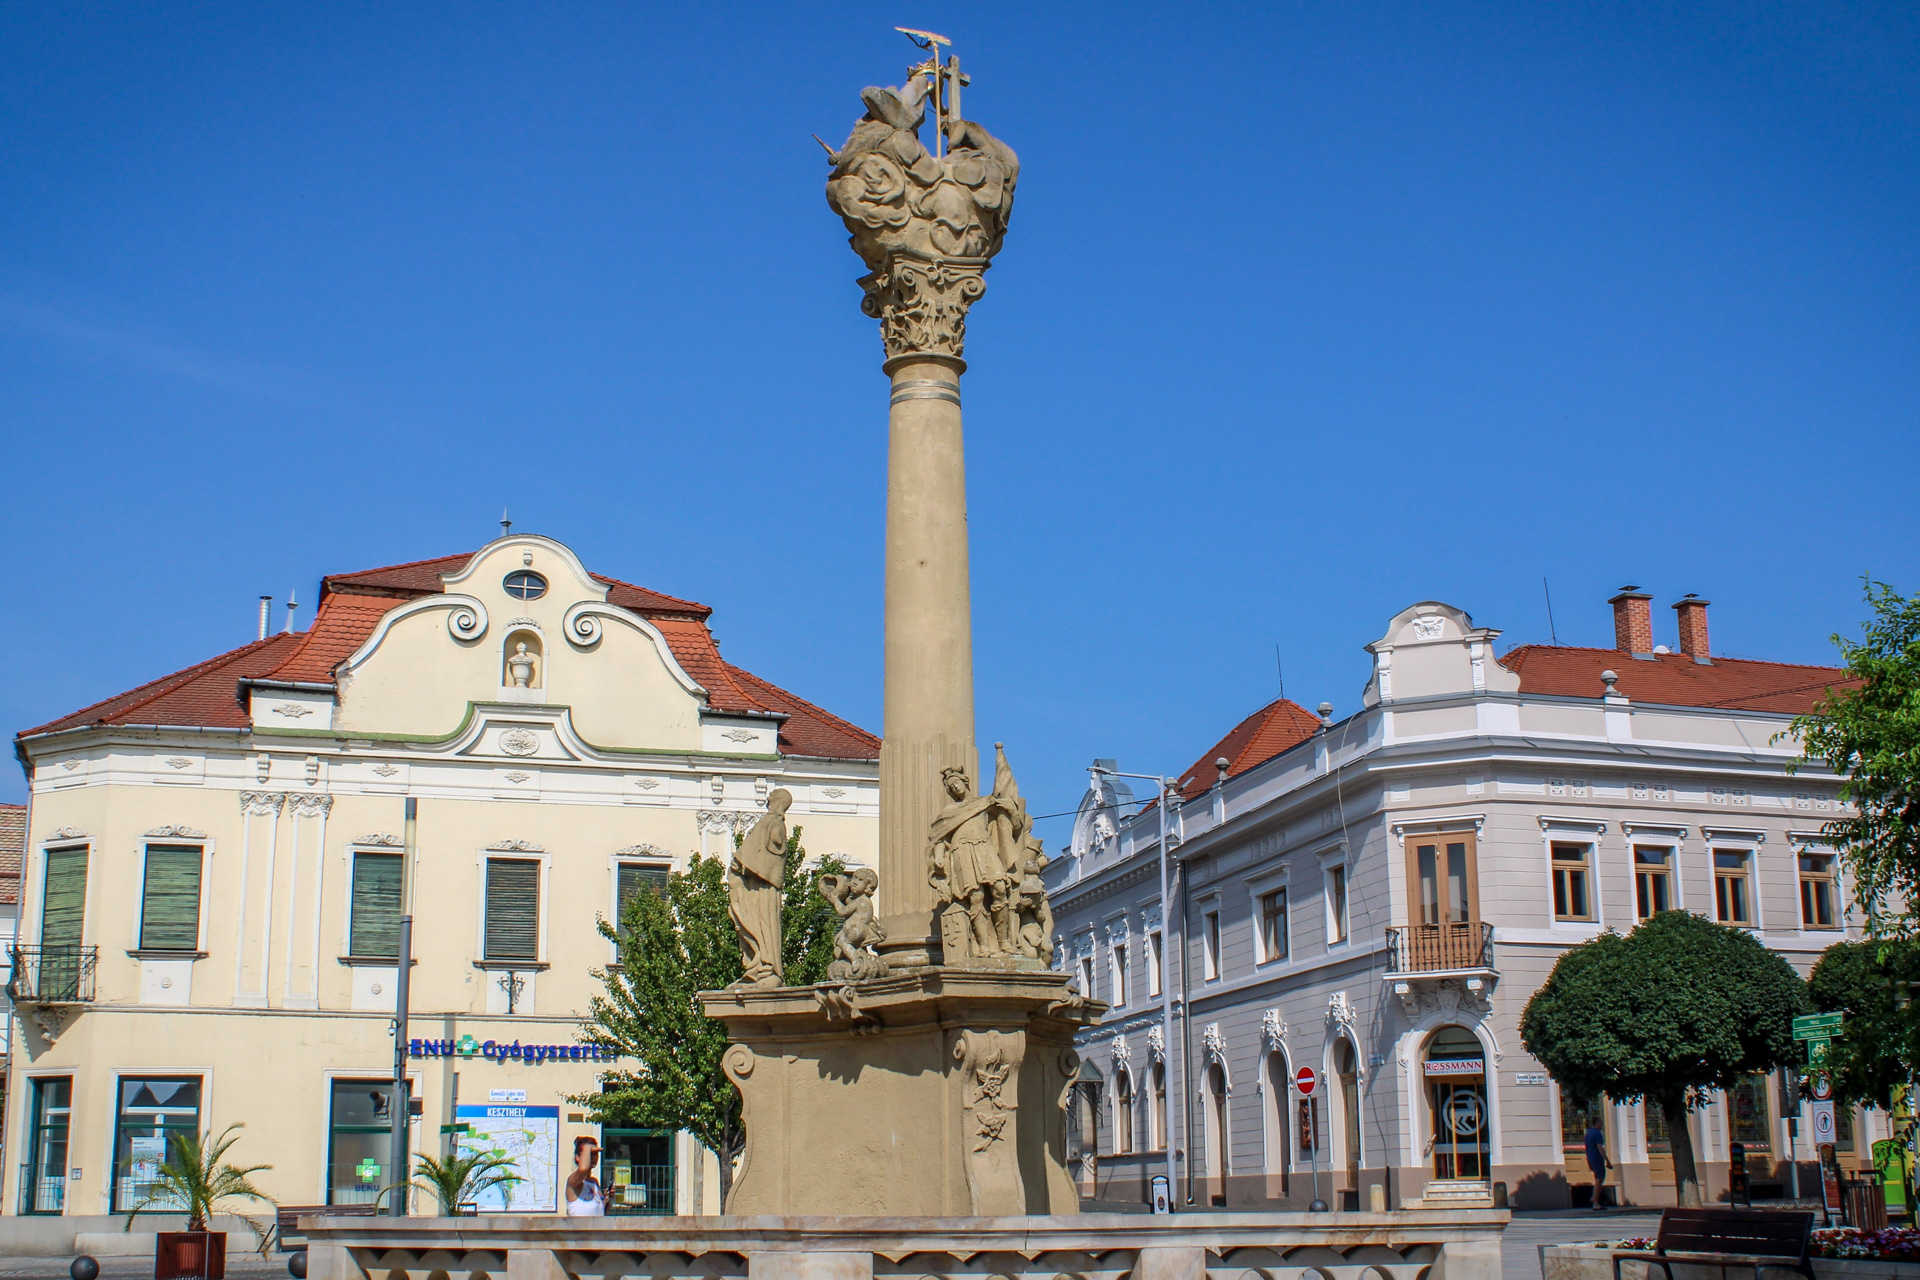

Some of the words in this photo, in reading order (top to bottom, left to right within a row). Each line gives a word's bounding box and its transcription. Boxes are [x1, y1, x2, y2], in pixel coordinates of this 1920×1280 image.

[410, 1038, 455, 1056] ENU
[482, 1039, 617, 1060] Gyógyszert
[1426, 1062, 1481, 1071] ROSSMANN
[487, 1107, 527, 1118] KESZTHELY
